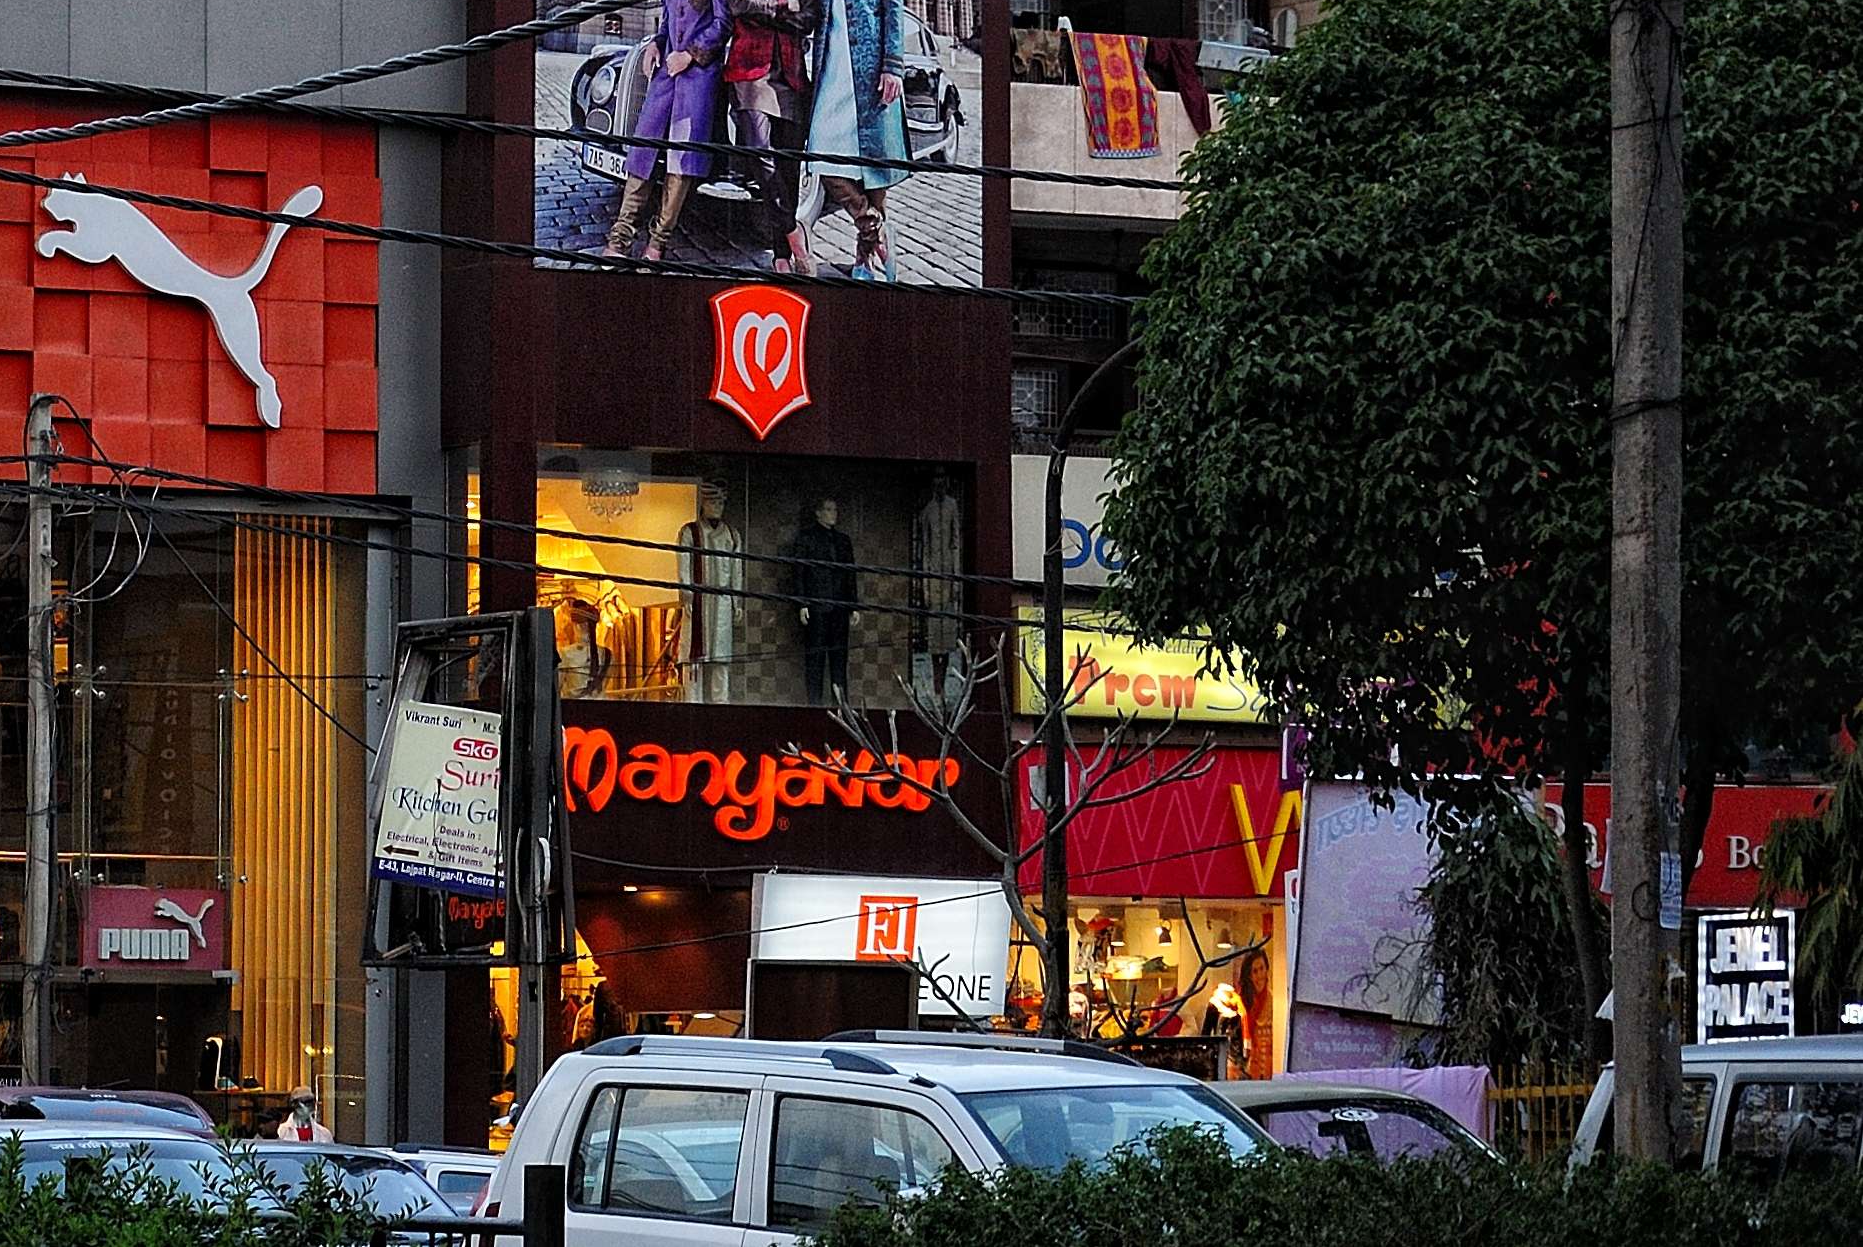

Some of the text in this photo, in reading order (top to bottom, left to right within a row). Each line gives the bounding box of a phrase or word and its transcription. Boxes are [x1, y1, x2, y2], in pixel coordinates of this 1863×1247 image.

[405, 710, 440, 726] Vikrant
[443, 716, 462, 730] Suri
[441, 760, 501, 792] Suri
[562, 726, 961, 841] Manyavar
[392, 786, 461, 821] Kitchen
[386, 831, 429, 846] Electrical,
[432, 837, 479, 855] Electronic
[439, 826, 465, 839] Deals
[438, 852, 456, 864] Gift
[457, 855, 484, 868] Items
[466, 876, 496, 888] Centra
[98, 927, 190, 961] PUMA
[1709, 924, 1787, 975] JEWEL
[1704, 980, 1790, 1026] PALACE
